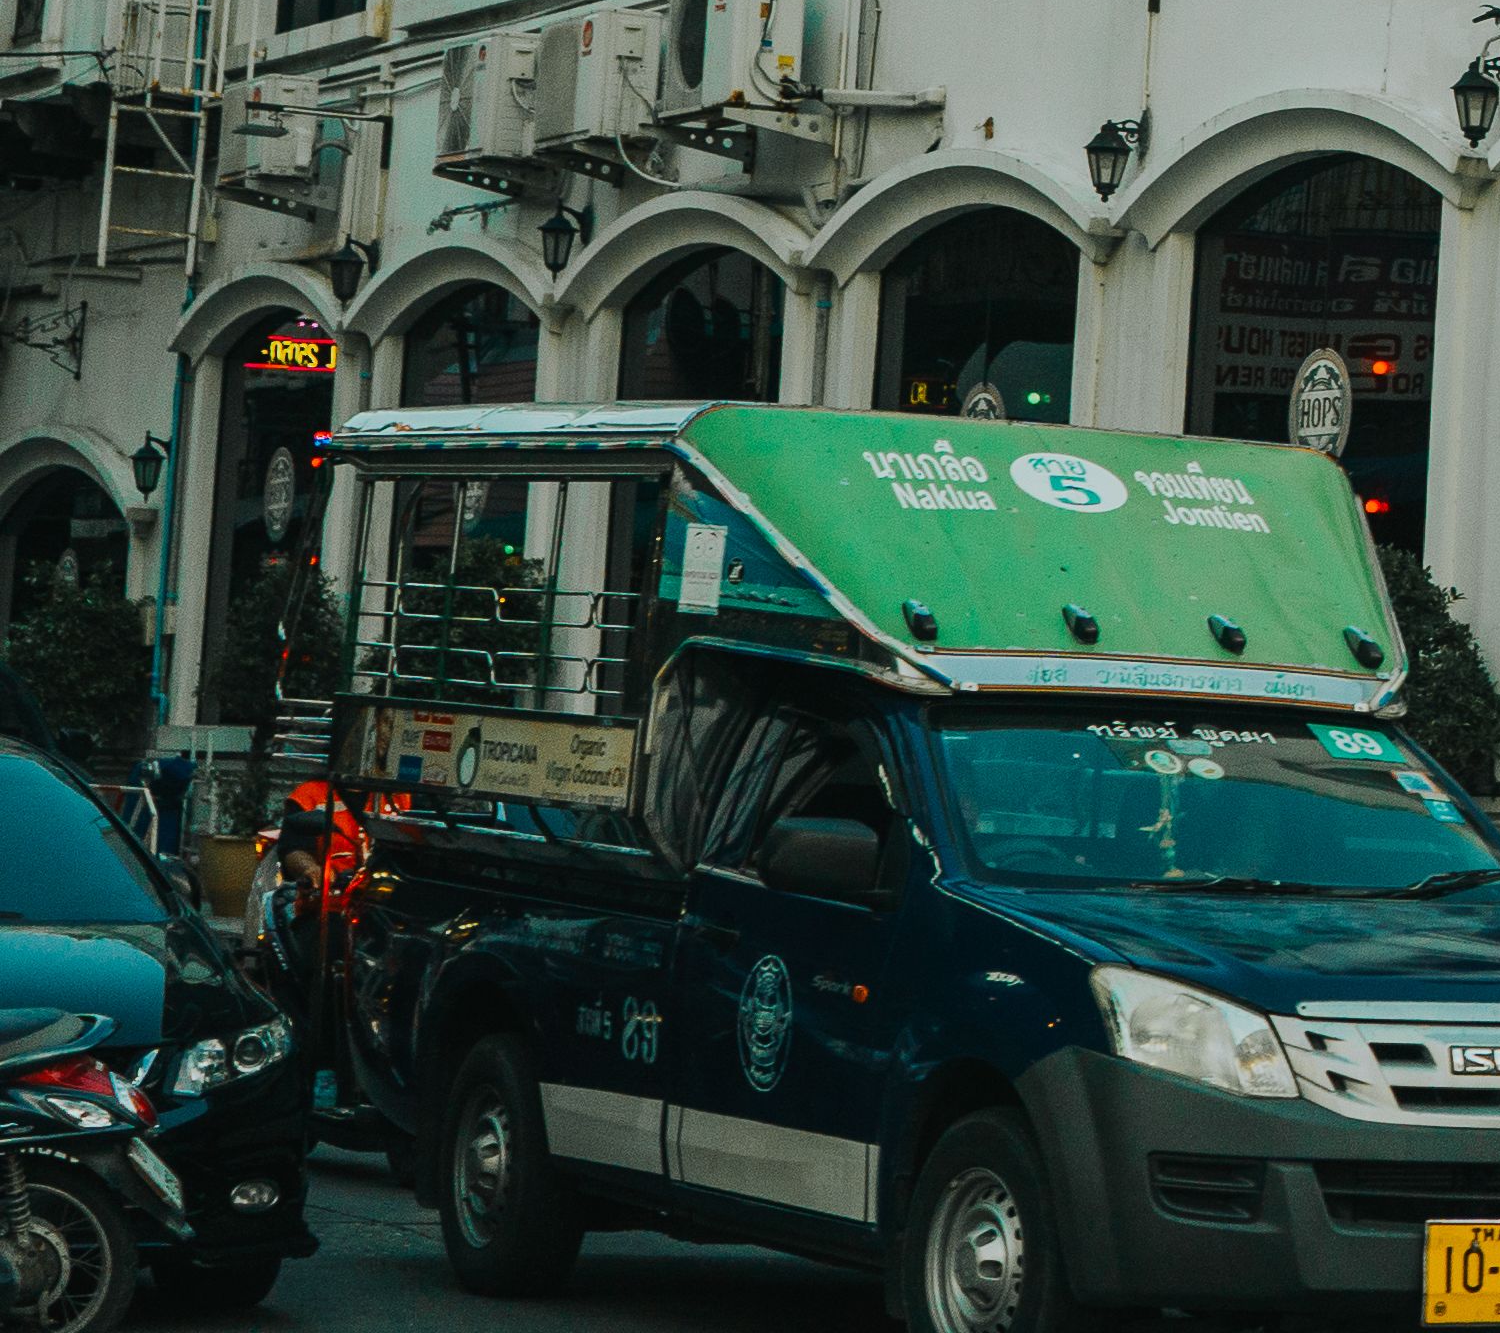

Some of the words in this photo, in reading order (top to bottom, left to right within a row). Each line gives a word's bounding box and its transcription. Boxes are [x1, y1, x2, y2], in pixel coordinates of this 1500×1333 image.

[1300, 395, 1343, 429] HOPS
[861, 437, 990, 484] นาเกลือ
[1027, 453, 1086, 478] สาย
[890, 480, 998, 512] Naklua
[1047, 473, 1103, 507] 5
[1133, 460, 1255, 506] จอมเทียน
[1162, 498, 1272, 534] Jomtien
[482, 739, 540, 765] TROPICANA
[569, 733, 607, 761] Organic
[1332, 727, 1386, 757] 89
[572, 762, 610, 787] Coconut
[621, 995, 660, 1065] 89
